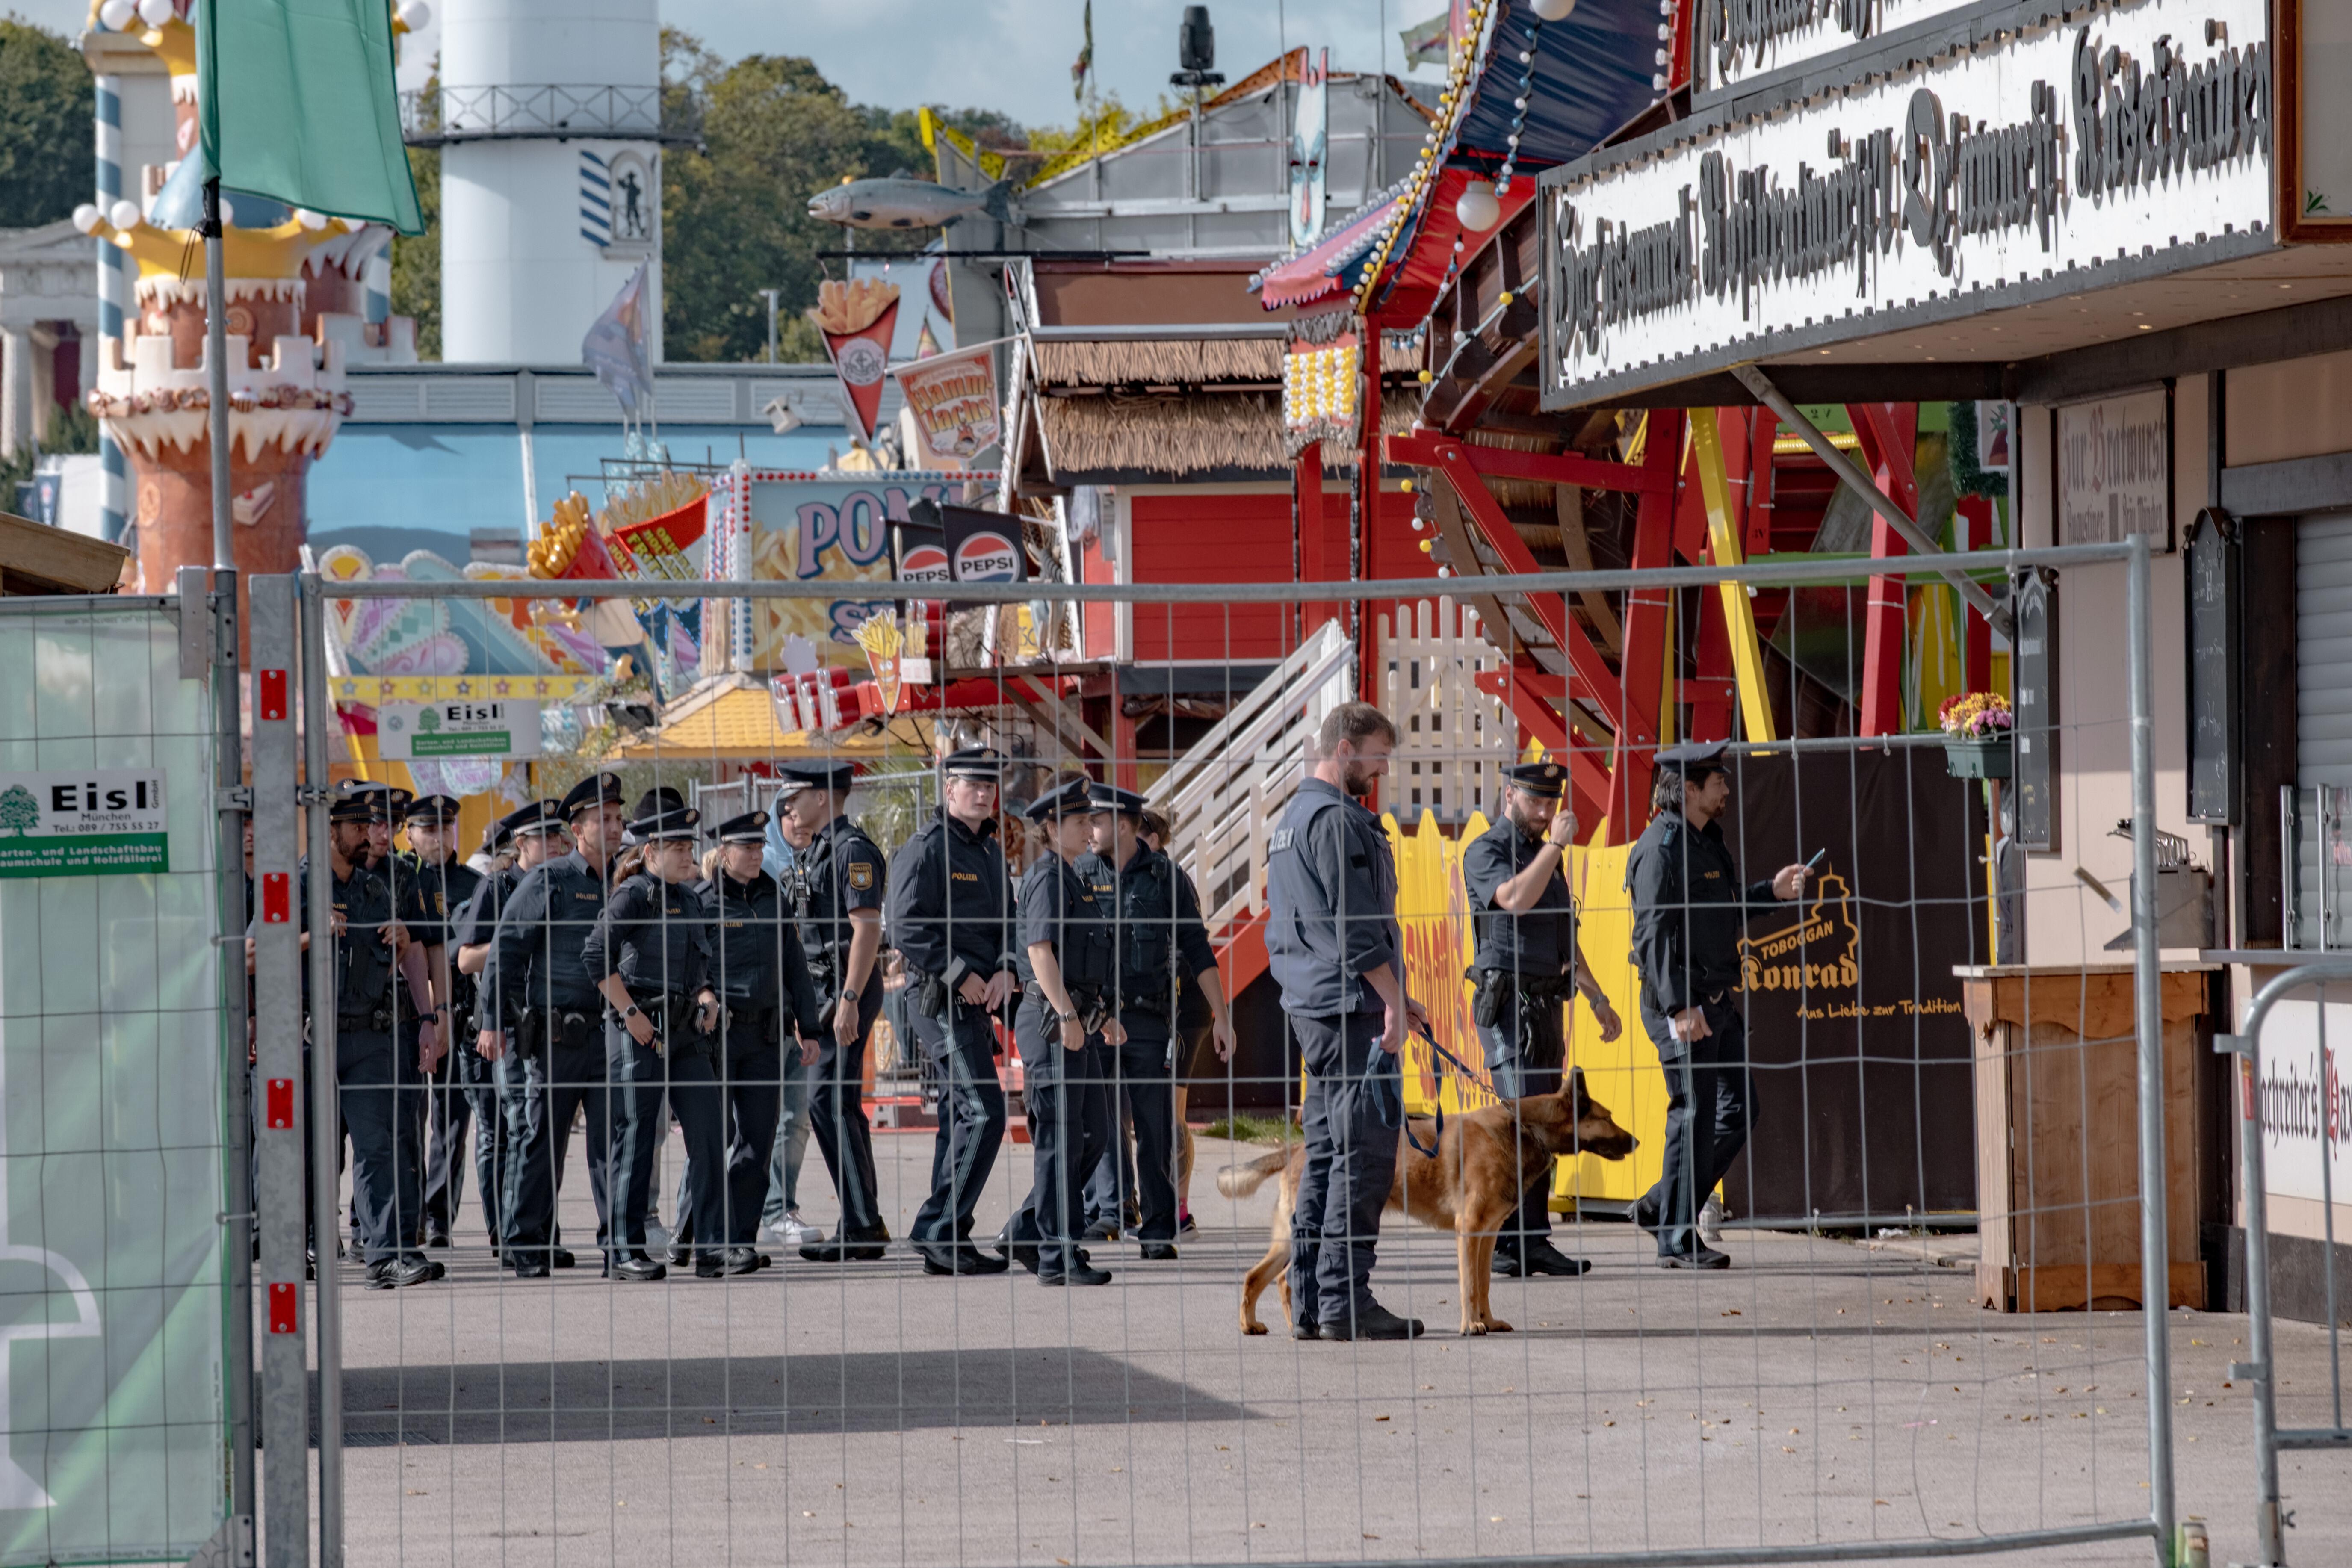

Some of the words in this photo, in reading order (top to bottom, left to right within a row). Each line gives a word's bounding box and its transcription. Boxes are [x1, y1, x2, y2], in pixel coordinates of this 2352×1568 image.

[2090, 398, 2166, 492] Bratwurst
[961, 557, 1013, 573] PEPSI
[904, 569, 948, 582] PEPS
[447, 704, 497, 720] Eisl
[52, 781, 147, 811] Eisl
[81, 812, 131, 822] München
[53, 824, 75, 833] Tel.:
[79, 824, 97, 832] 089
[109, 822, 127, 831] 755
[132, 822, 143, 830] 55
[148, 821, 159, 830] 27
[0, 849, 37, 858] arten-
[42, 847, 65, 856] und
[69, 844, 162, 855] Landschaftsbau
[0, 857, 62, 867] aumschule
[67, 856, 89, 865] und
[93, 853, 162, 865] Holzfällerei
[951, 872, 978, 881] POLIZEI
[1761, 920, 1833, 961] TOBOGGAN
[1732, 953, 1859, 993] Konrad
[1797, 1003, 1824, 1019] Aus
[1828, 1000, 1870, 1018] Liebe
[1873, 1005, 1897, 1016] zur
[1898, 997, 1962, 1016] Tradition
[2261, 1051, 2318, 1149] ochreiter's
